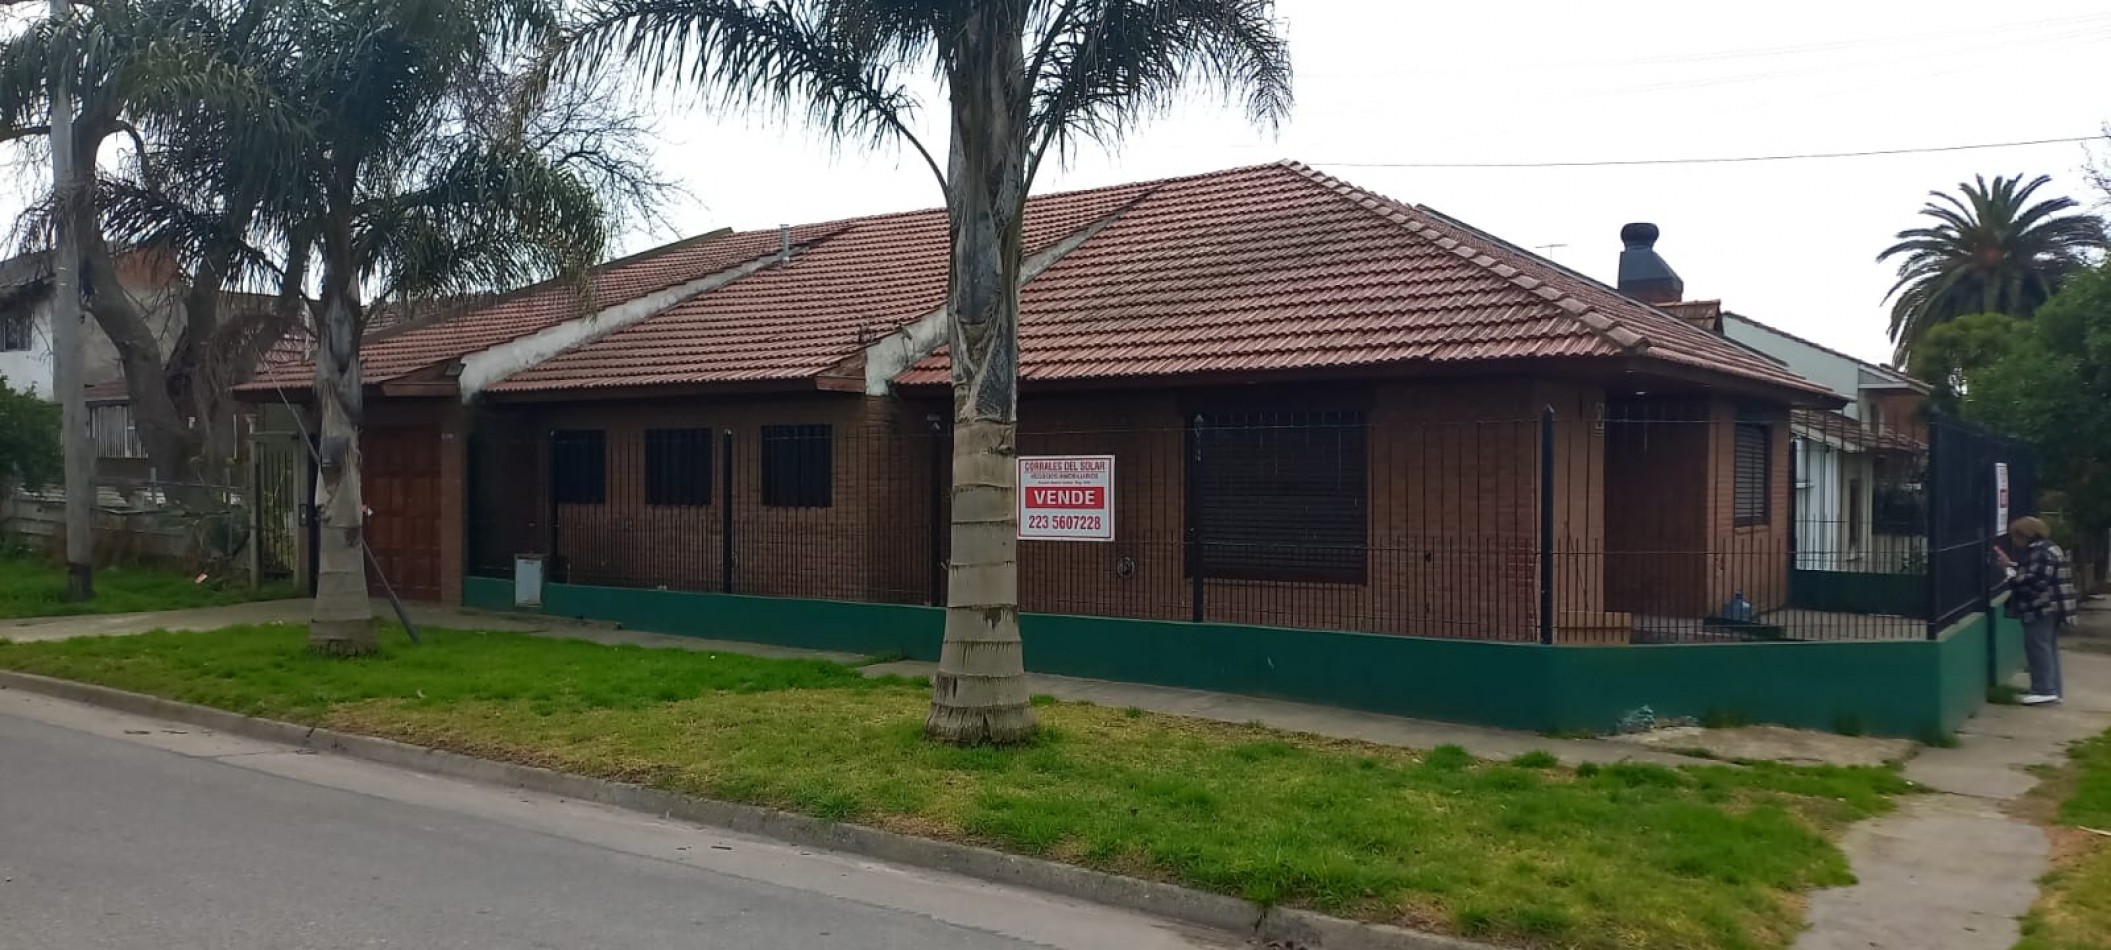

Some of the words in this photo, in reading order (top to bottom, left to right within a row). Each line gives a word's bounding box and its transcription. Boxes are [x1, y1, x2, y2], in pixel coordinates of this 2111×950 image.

[1025, 462, 1062, 471] CORRALES
[1064, 462, 1078, 471] DEL
[1080, 461, 1105, 470] SOLAR
[1033, 490, 1095, 505] VENDE
[1028, 515, 1049, 529] 223
[1052, 515, 1101, 530] 5607228
